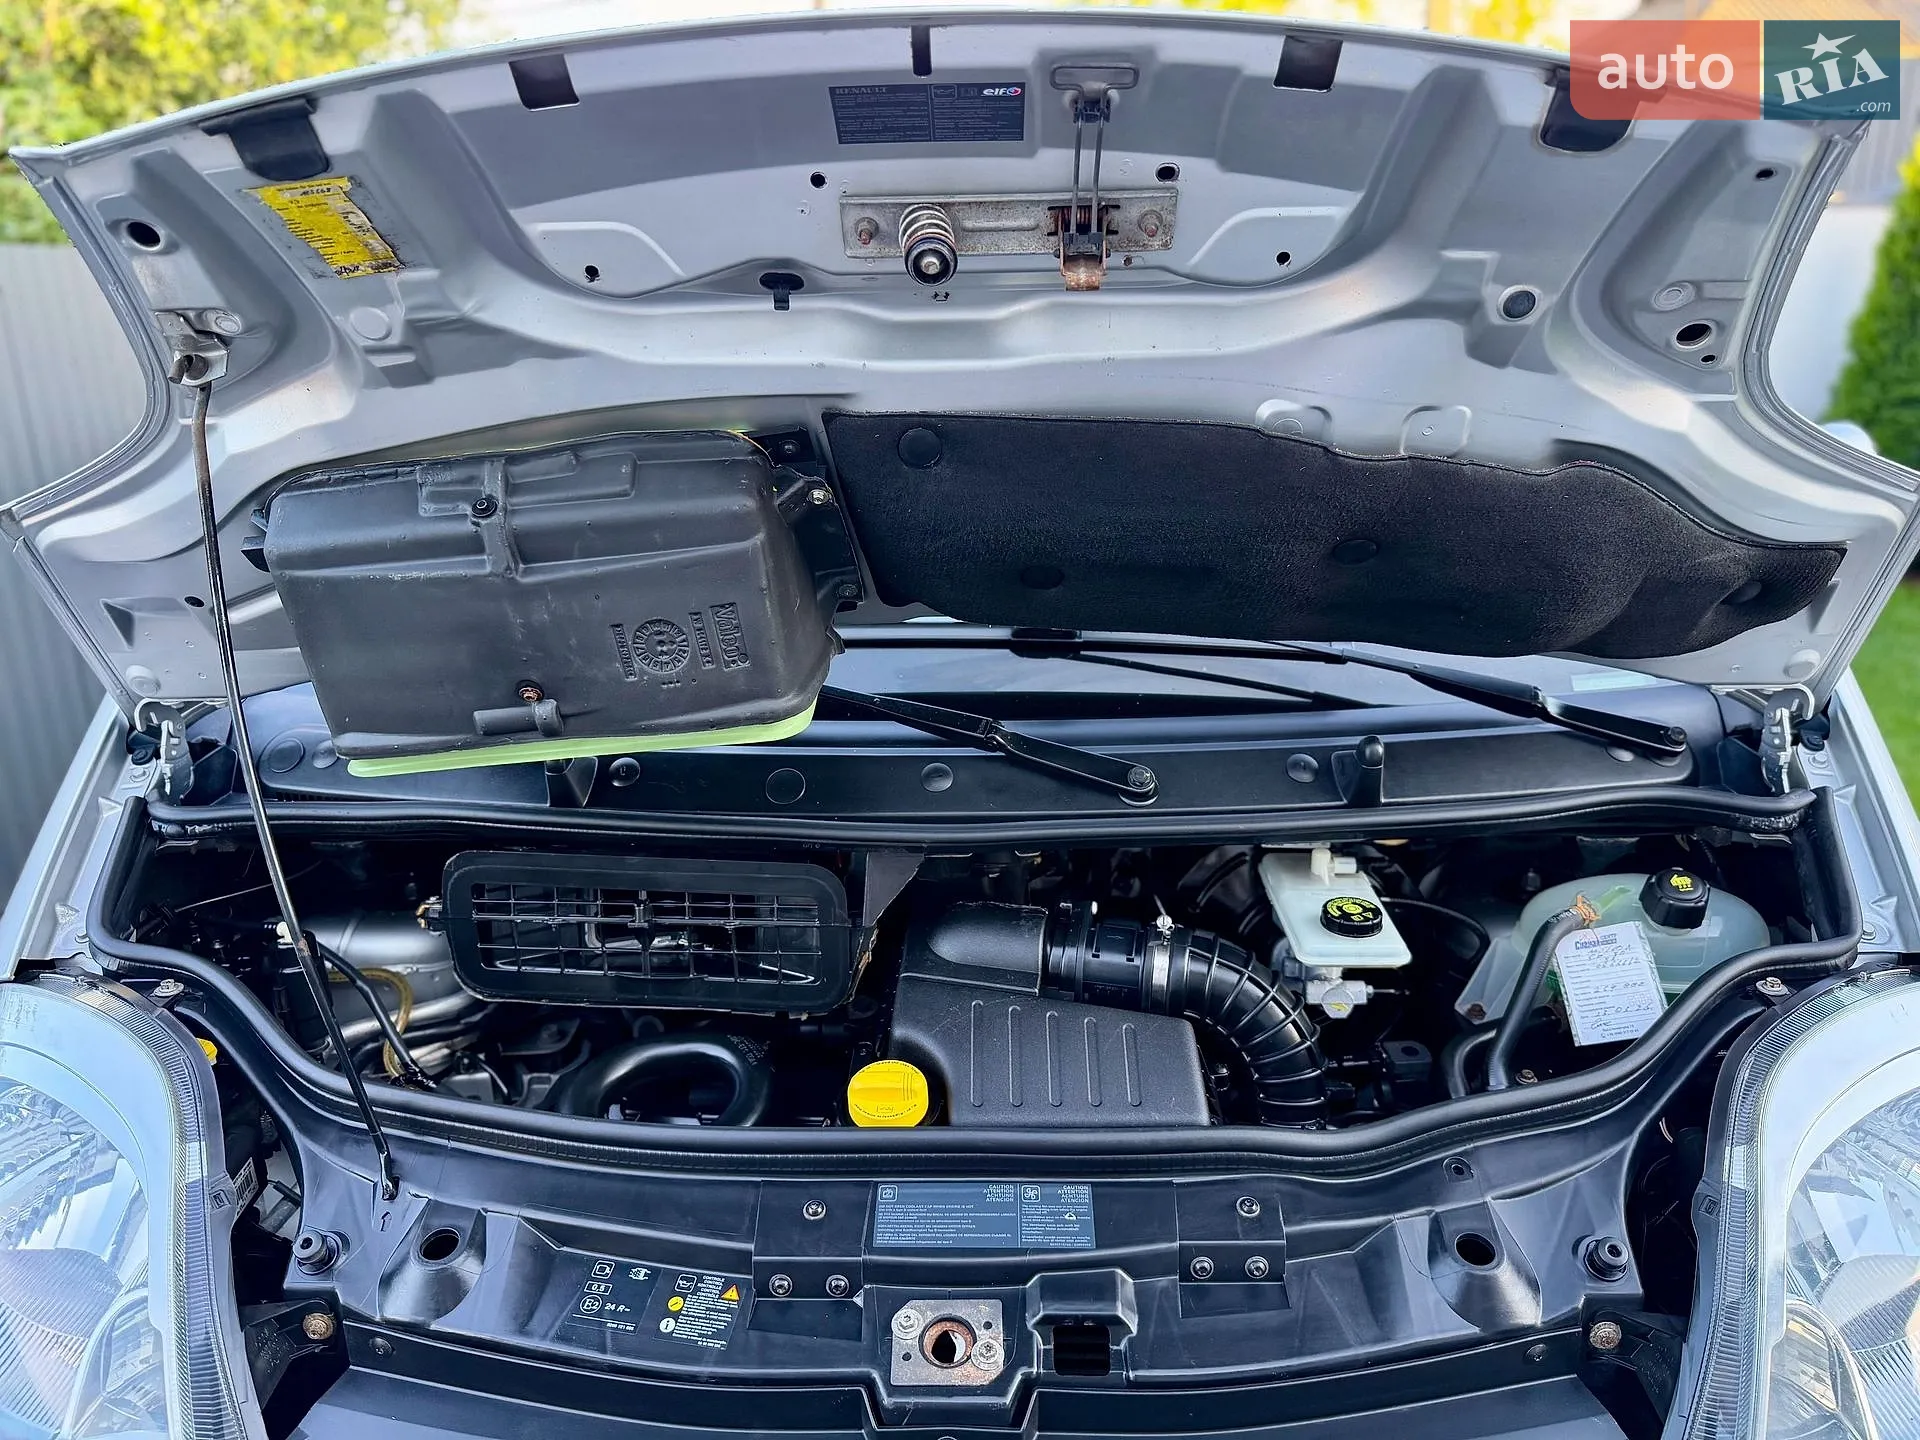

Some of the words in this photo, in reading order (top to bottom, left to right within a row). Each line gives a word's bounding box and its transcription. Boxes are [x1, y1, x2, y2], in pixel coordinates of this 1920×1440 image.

[835, 87, 887, 95] RENAULT
[982, 87, 1007, 96] elf
[714, 604, 742, 661] Valeo
[604, 1302, 616, 1311] 24
